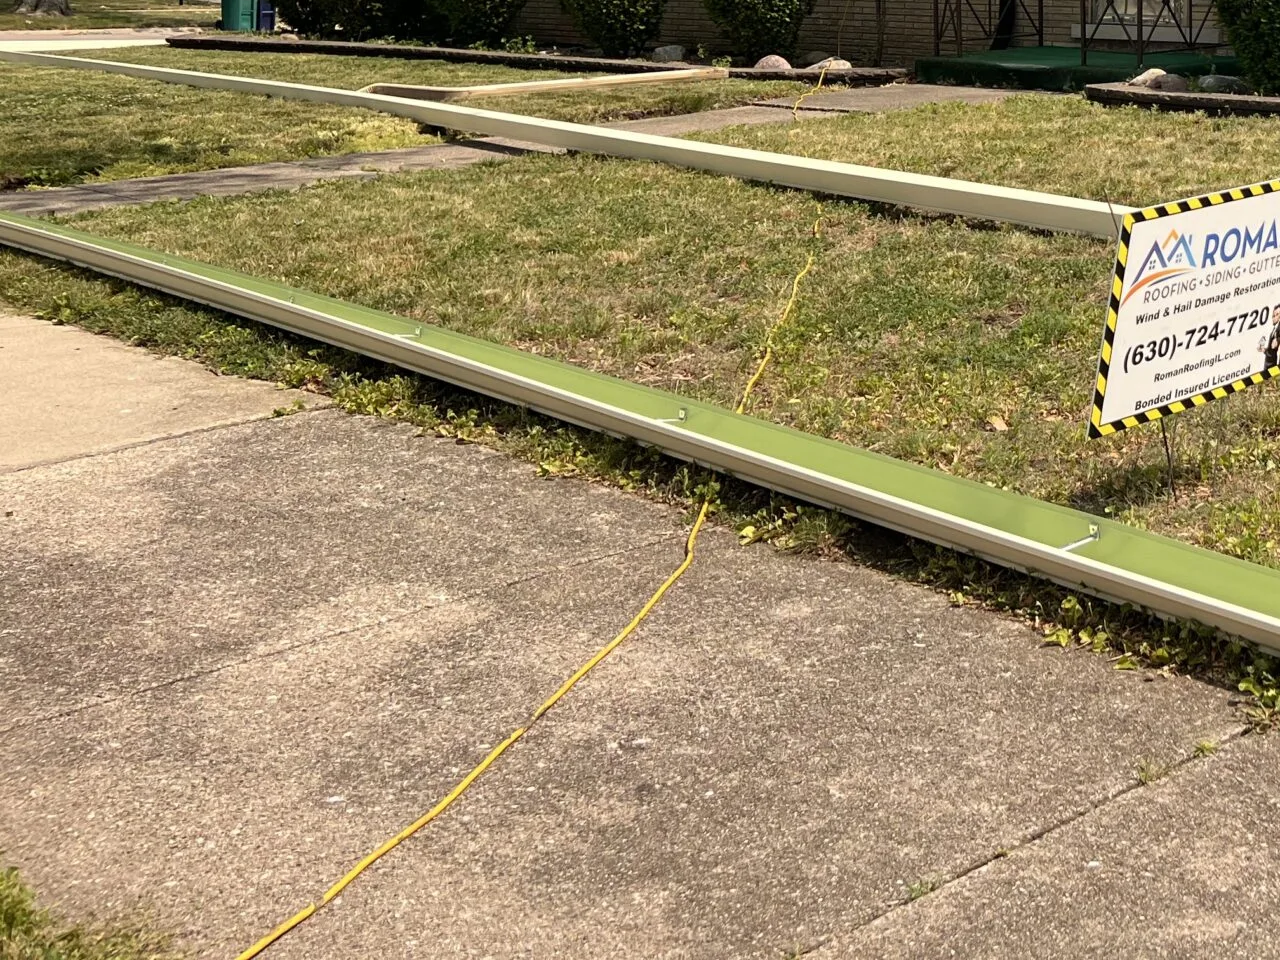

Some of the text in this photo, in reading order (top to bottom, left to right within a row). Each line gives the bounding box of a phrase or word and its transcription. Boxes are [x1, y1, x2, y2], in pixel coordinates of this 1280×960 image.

[1143, 278, 1197, 304] ROOFING
[1204, 268, 1241, 287] SIDING
[1135, 309, 1160, 326] Wind
[1163, 307, 1170, 317] &
[1173, 300, 1192, 315] Hail
[1194, 292, 1231, 309] Damage
[1123, 305, 1270, 373] (630)-724-7720
[1153, 348, 1241, 383] RomanRoofingIL.com
[1134, 364, 1251, 411] Bonded Insured Licenced
